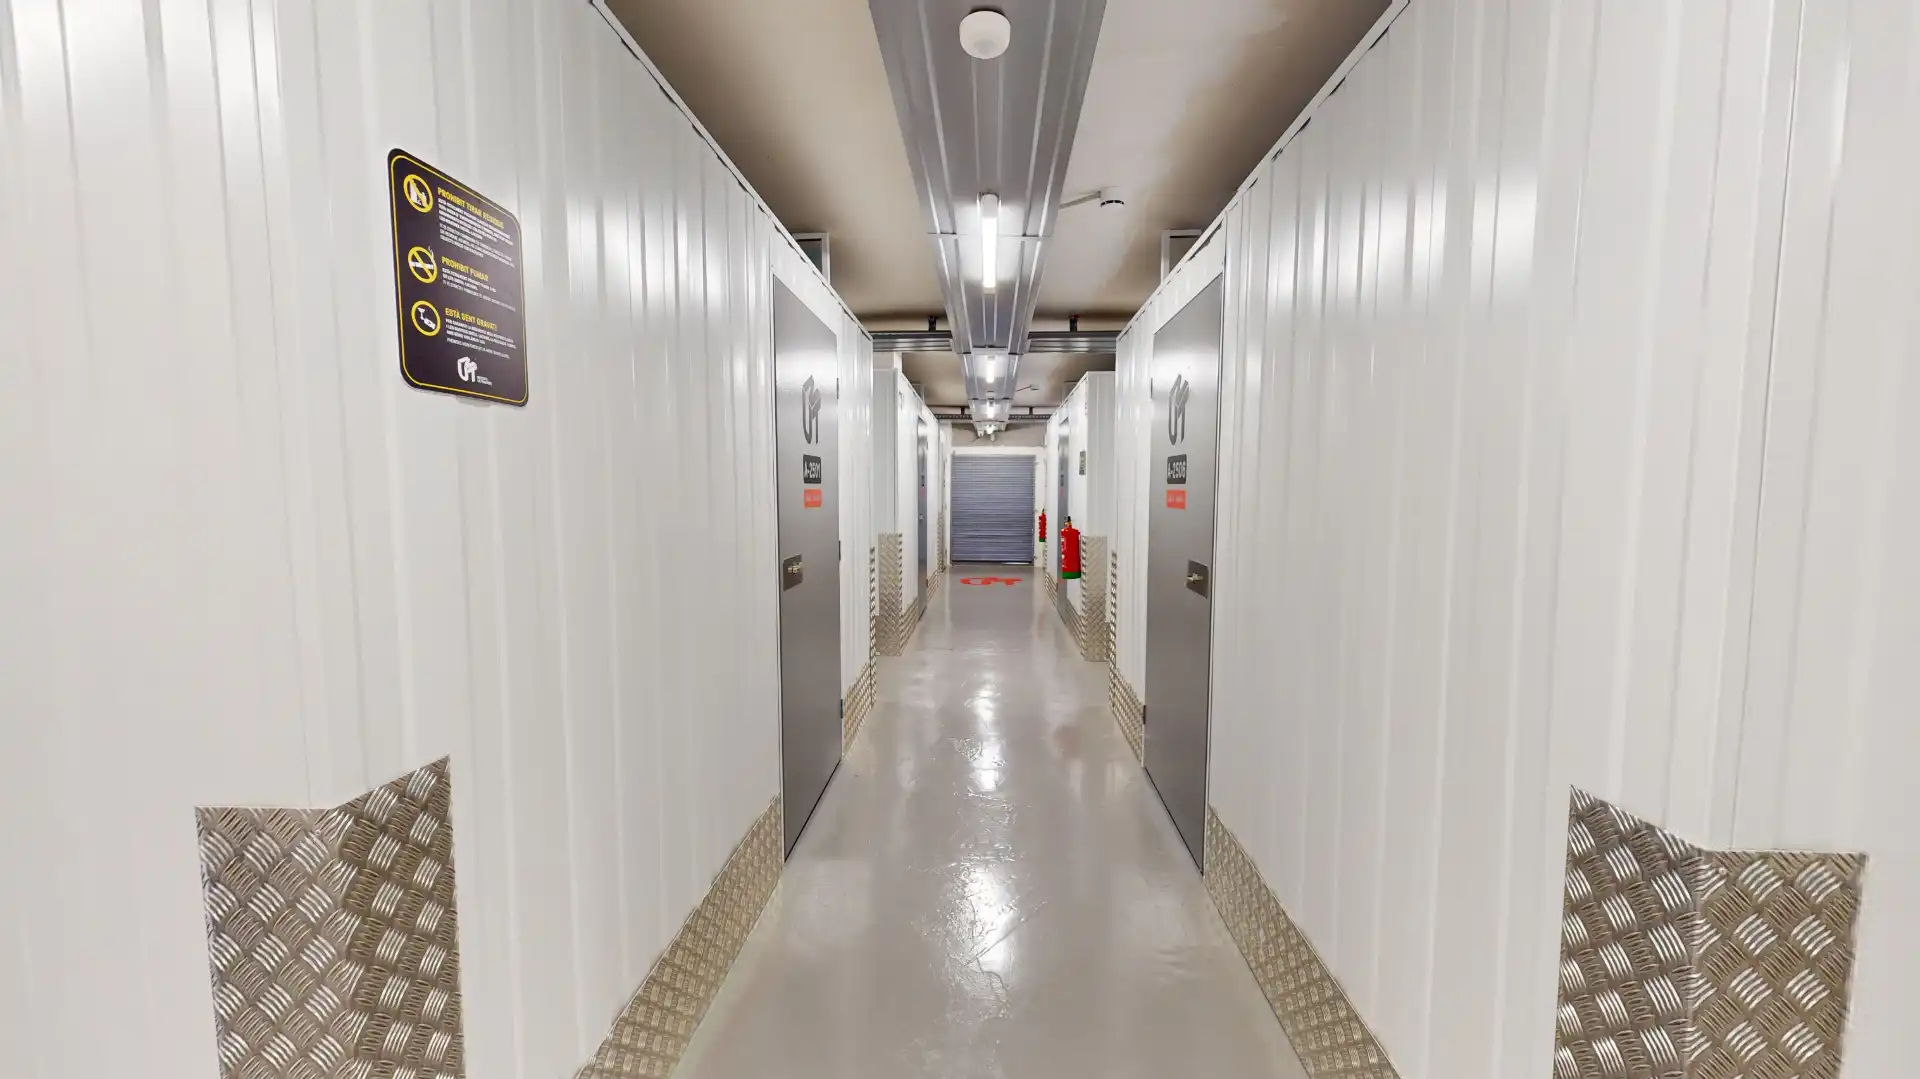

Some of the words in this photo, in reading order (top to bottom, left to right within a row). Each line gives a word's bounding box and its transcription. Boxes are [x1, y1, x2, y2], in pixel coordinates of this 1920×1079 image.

[437, 186, 466, 208] PROHIBIT
[441, 255, 469, 274] PROHIBIT
[445, 307, 460, 320] ESTÀ
[804, 461, 820, 478] A-2501
[1168, 461, 1185, 478] A-2506
